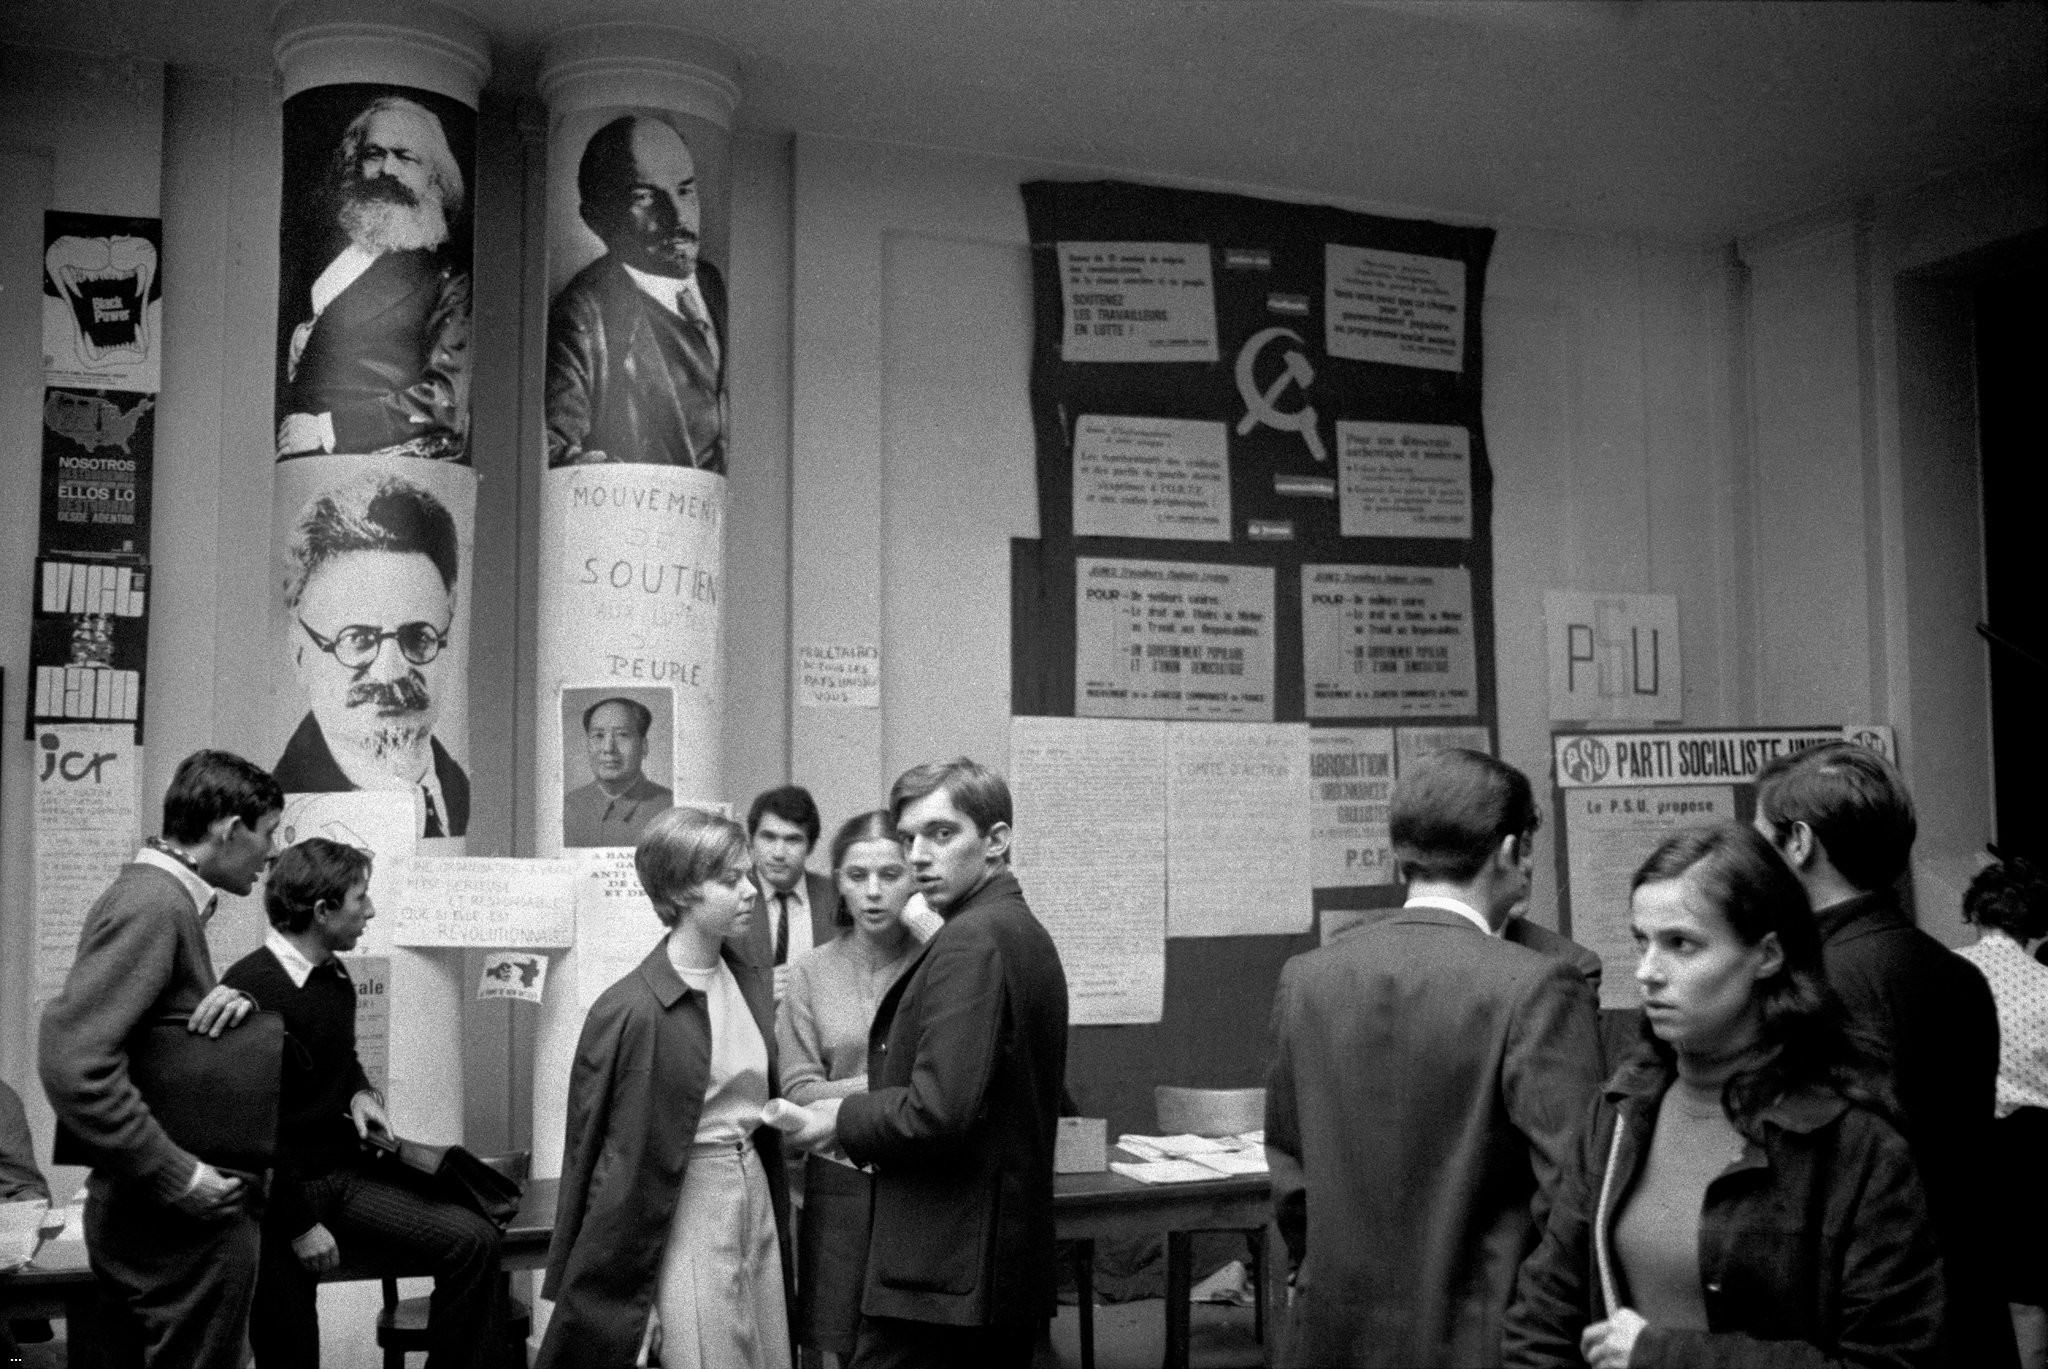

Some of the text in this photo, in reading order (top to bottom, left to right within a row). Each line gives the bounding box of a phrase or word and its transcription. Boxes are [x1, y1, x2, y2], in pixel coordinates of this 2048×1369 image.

[59, 456, 136, 471] NOSOTROS
[58, 485, 135, 502] ELLOS LO
[580, 557, 716, 605] SOUTIEN
[1086, 589, 1119, 601] POUR
[1312, 594, 1344, 606] POUR
[606, 654, 701, 687] PEUPLE
[1563, 739, 1609, 785] PSU
[1616, 740, 1673, 779] PARTI
[1587, 800, 1602, 814] Le
[1658, 799, 1714, 815] propose
